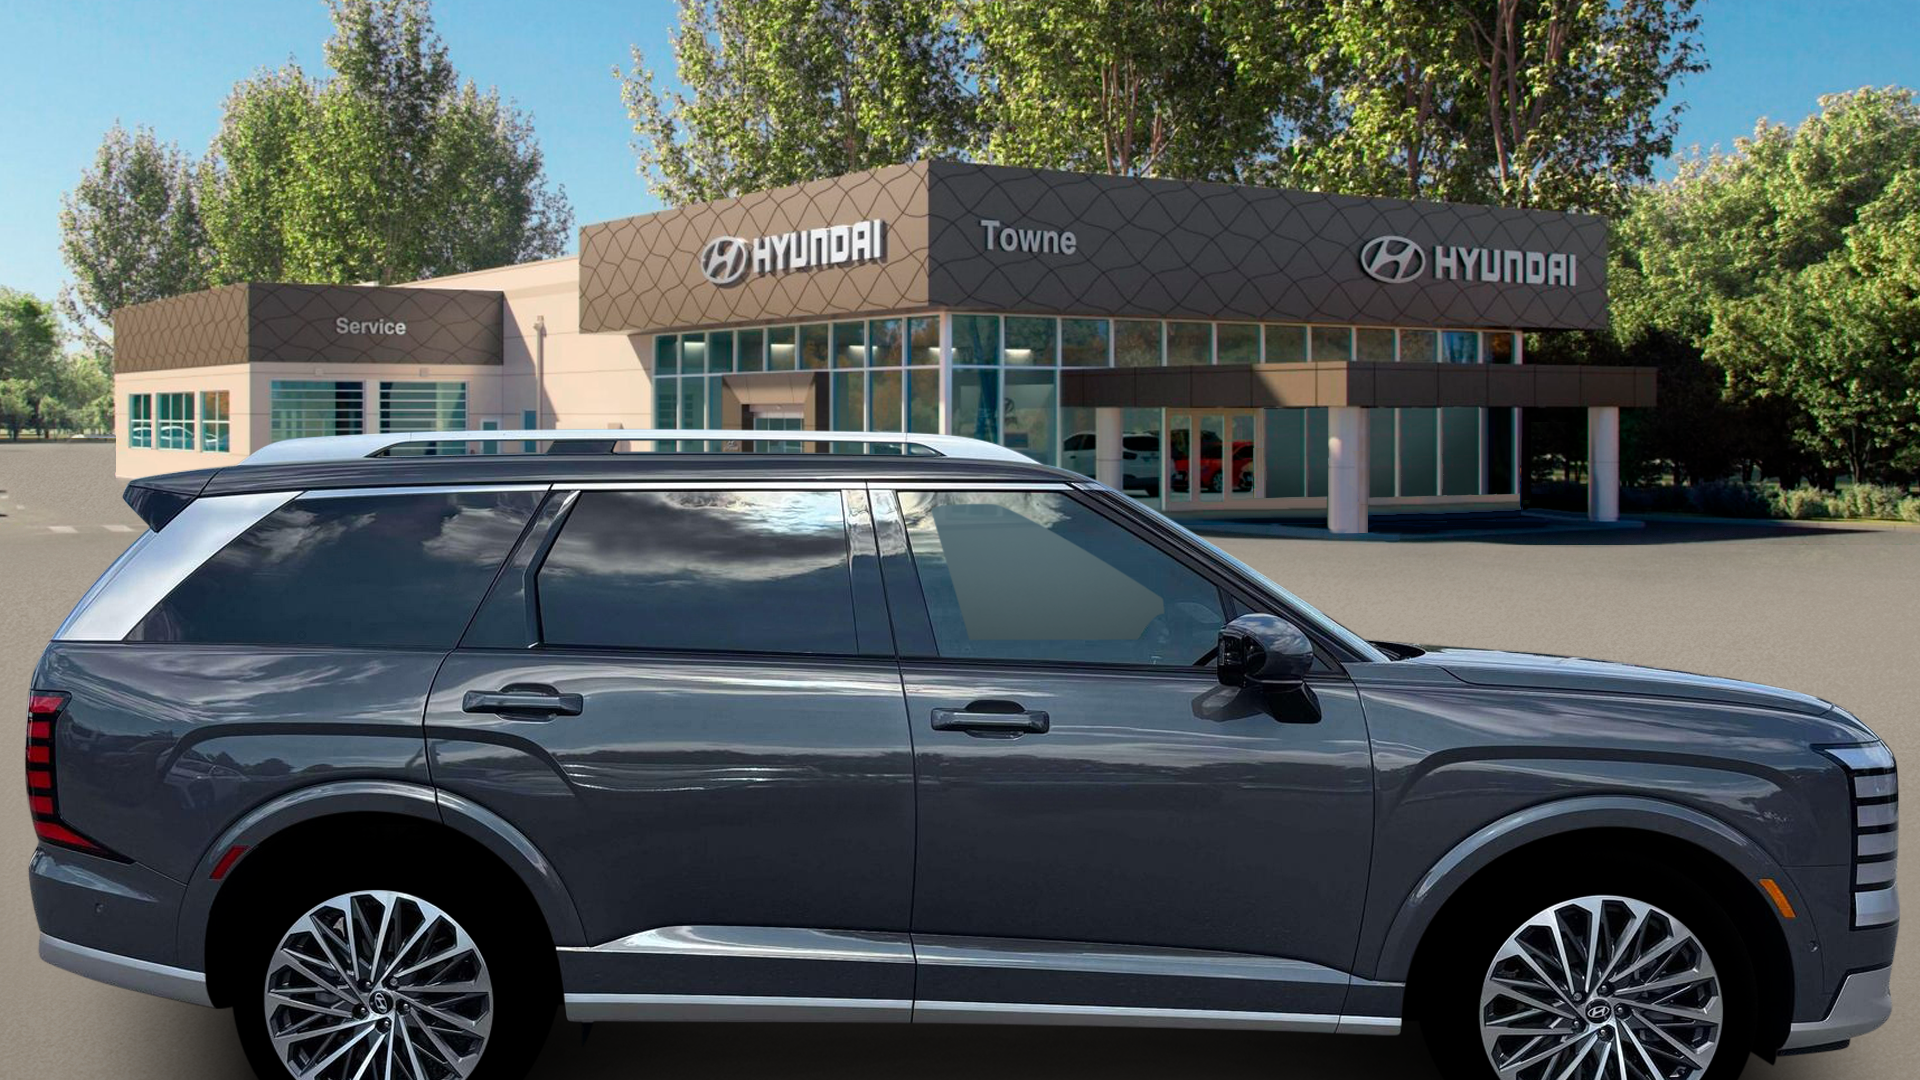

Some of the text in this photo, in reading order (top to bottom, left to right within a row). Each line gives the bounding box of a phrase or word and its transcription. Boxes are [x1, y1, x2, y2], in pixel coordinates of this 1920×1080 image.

[753, 219, 882, 273] HYUNDAI
[980, 220, 1077, 255] Towne
[1434, 245, 1577, 287] HYUNDAI
[335, 317, 407, 335] Service
